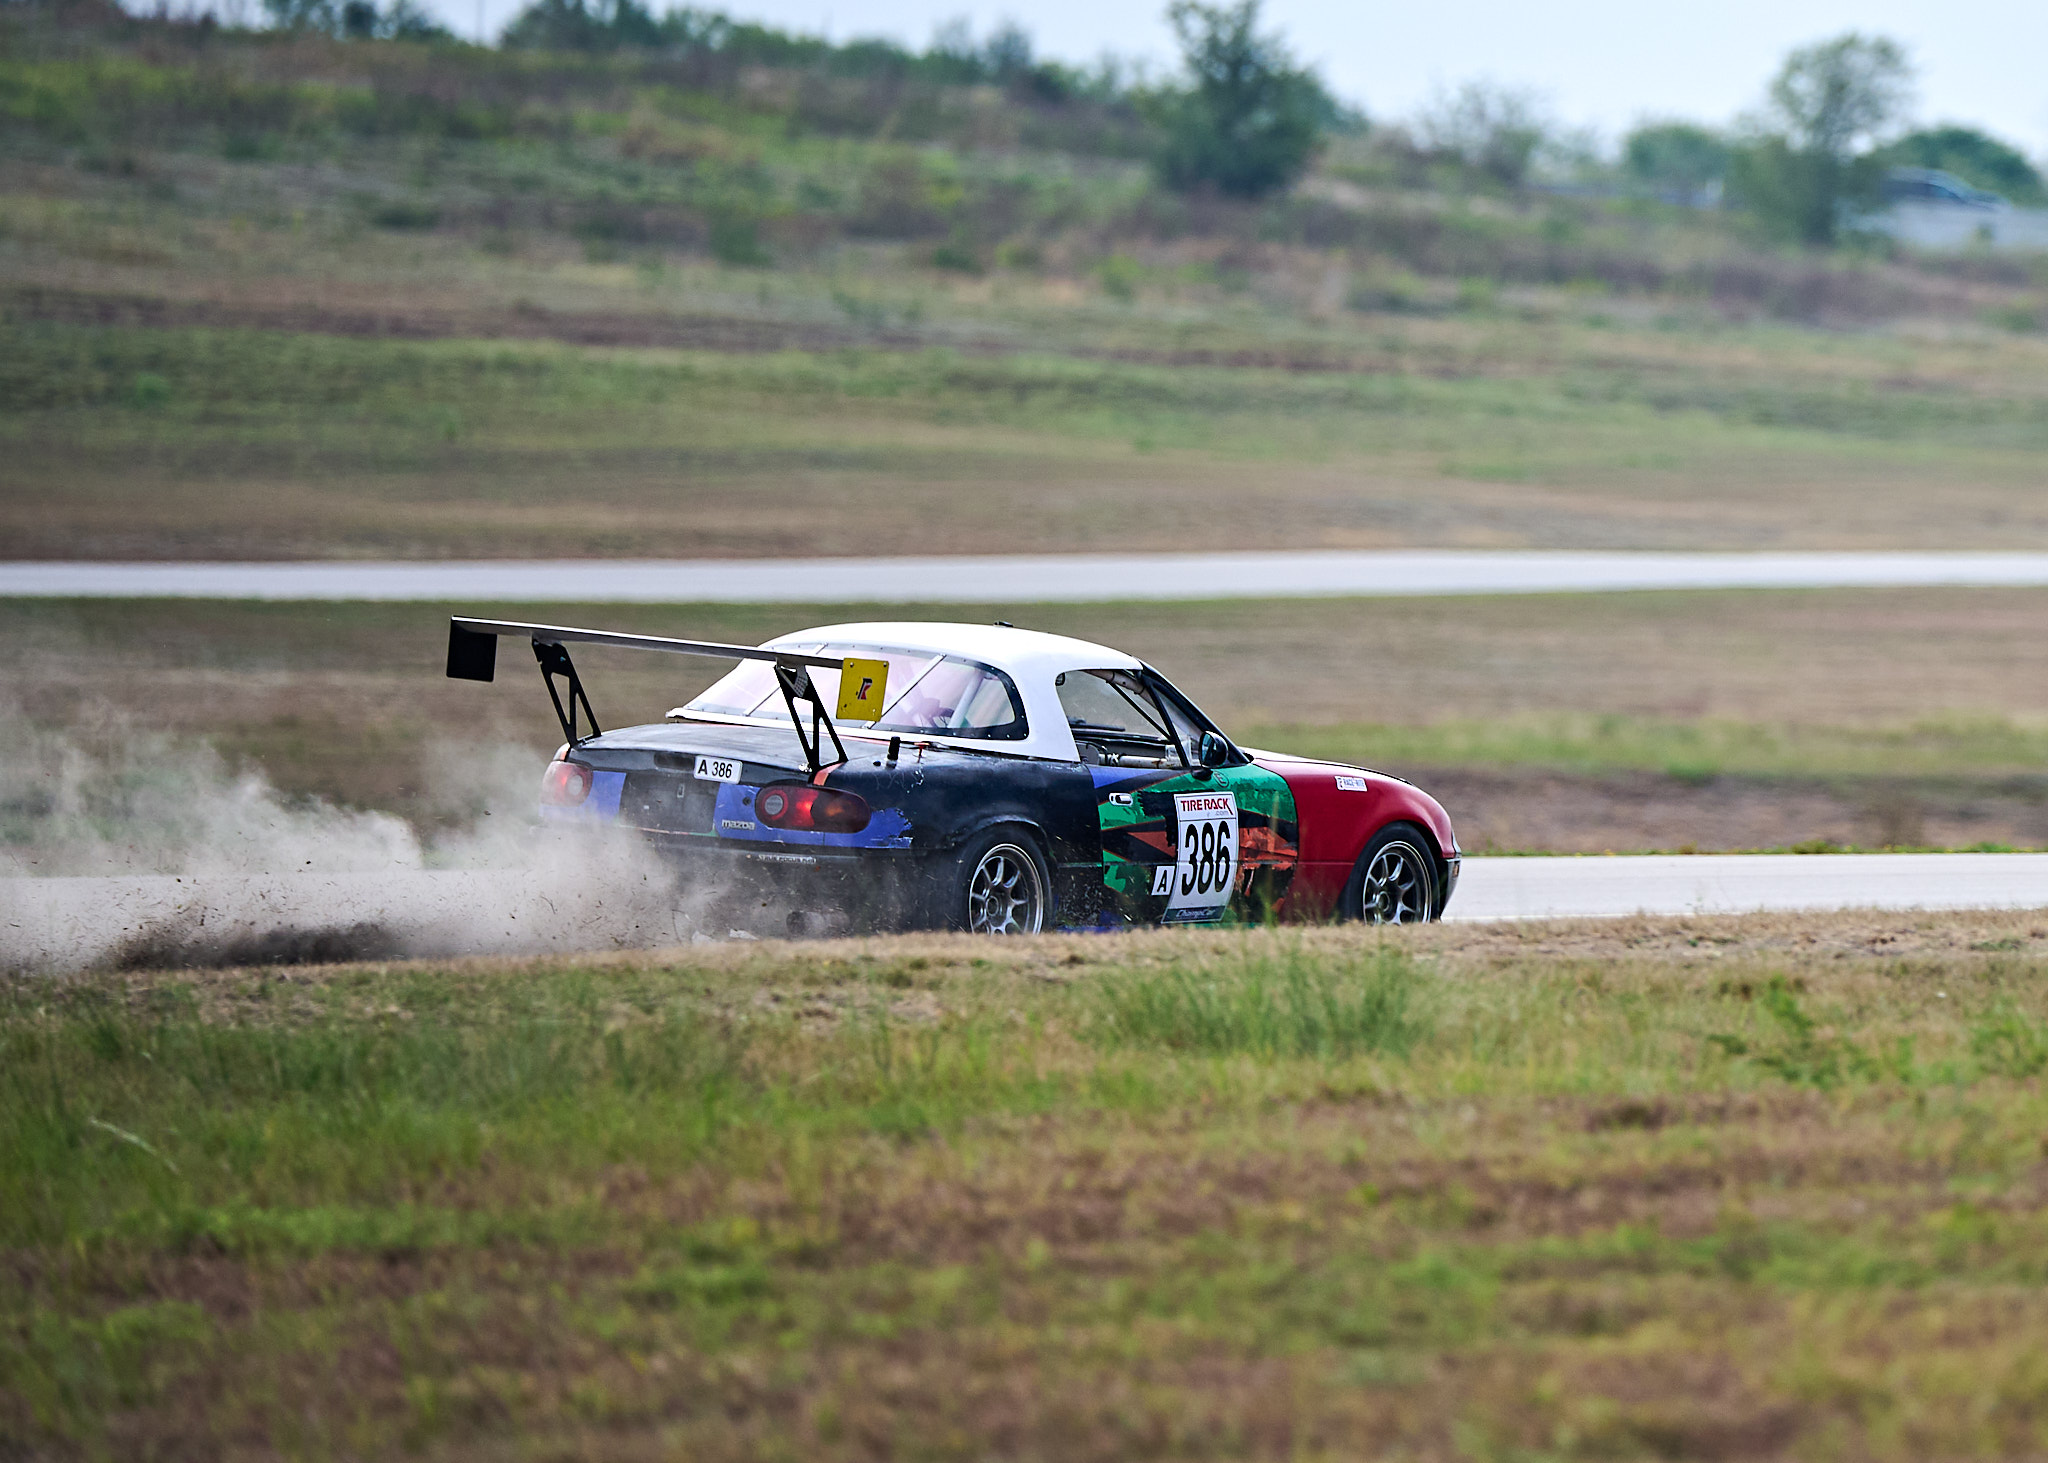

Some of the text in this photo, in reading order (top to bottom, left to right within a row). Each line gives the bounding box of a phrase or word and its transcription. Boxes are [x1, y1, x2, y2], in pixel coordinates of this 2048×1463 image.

[697, 759, 733, 778] A 386
[1180, 798, 1234, 815] TIRE RACK
[1181, 820, 1231, 896] 386
[1156, 869, 1168, 892] A
